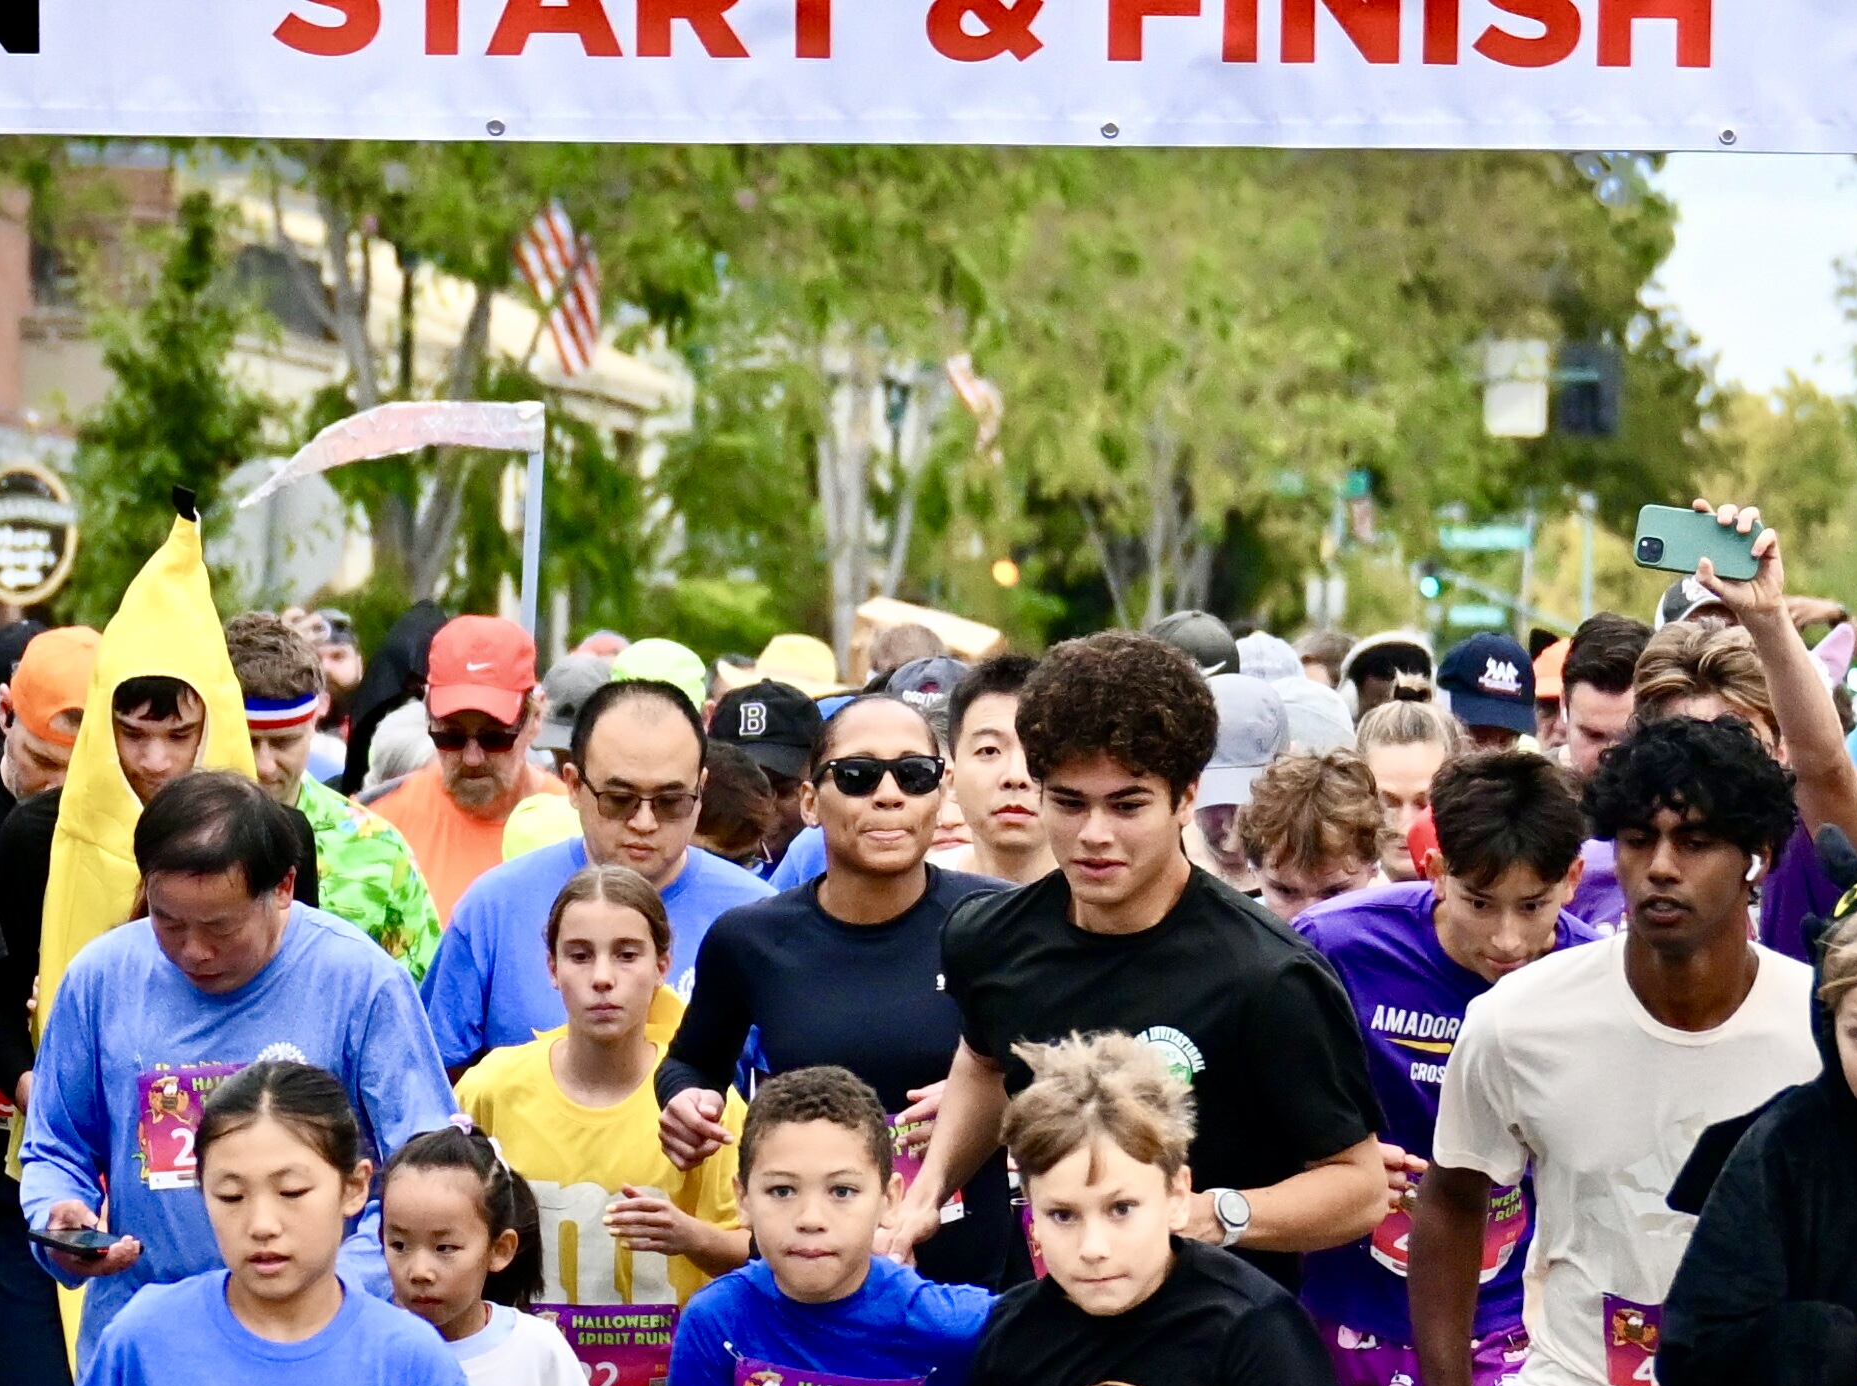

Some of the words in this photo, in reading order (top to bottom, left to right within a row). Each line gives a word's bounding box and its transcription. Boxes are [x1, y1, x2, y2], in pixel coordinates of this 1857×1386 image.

[739, 702, 767, 736] B
[1370, 1004, 1460, 1040] AMADOR
[1148, 1025, 1206, 1073] INVITATIONAL
[1410, 1061, 1446, 1084] CROS
[572, 1315, 673, 1329] HALLOWEEN
[577, 1332, 630, 1346] SPIRIT
[634, 1332, 672, 1345] RUN
